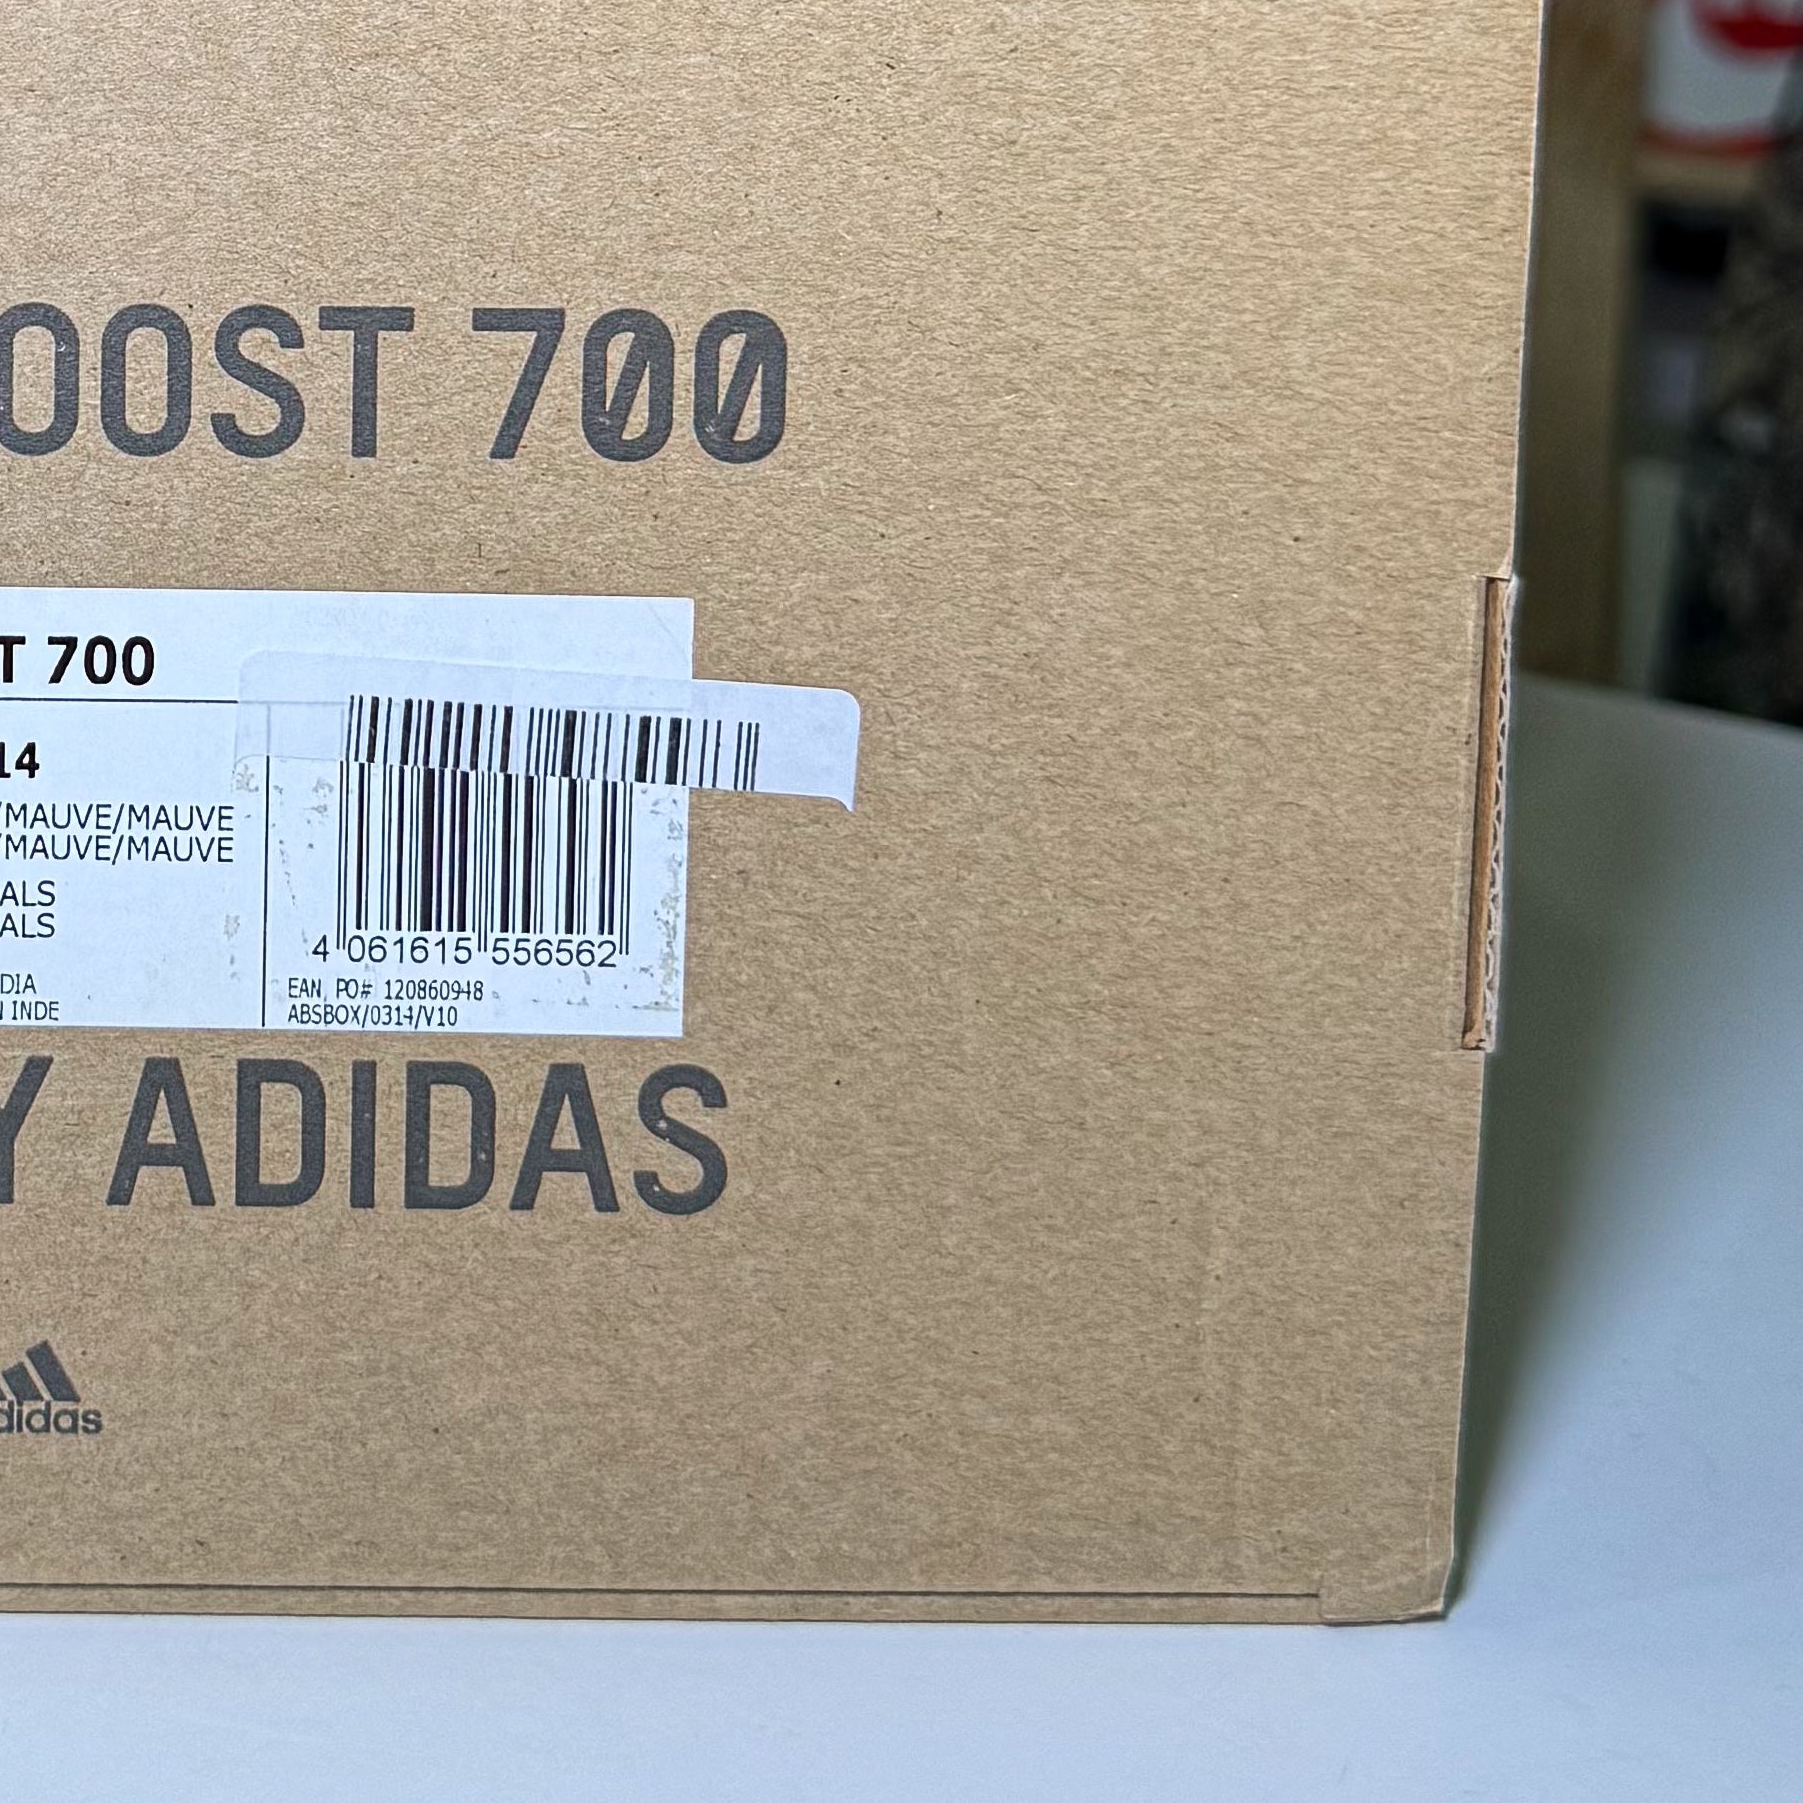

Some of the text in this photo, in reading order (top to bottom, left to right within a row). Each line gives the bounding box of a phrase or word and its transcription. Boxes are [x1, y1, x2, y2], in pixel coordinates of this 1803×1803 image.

[472, 307, 788, 464] 700
[47, 634, 154, 686] 700
[311, 935, 617, 968] 4 061615 556562
[336, 977, 374, 1000] PO#
[384, 978, 484, 1002] 120860948
[11, 1000, 60, 1022] INDE
[287, 1003, 458, 1030] ABSBOX/0314/V10
[105, 1056, 728, 1216] ADIDAS
